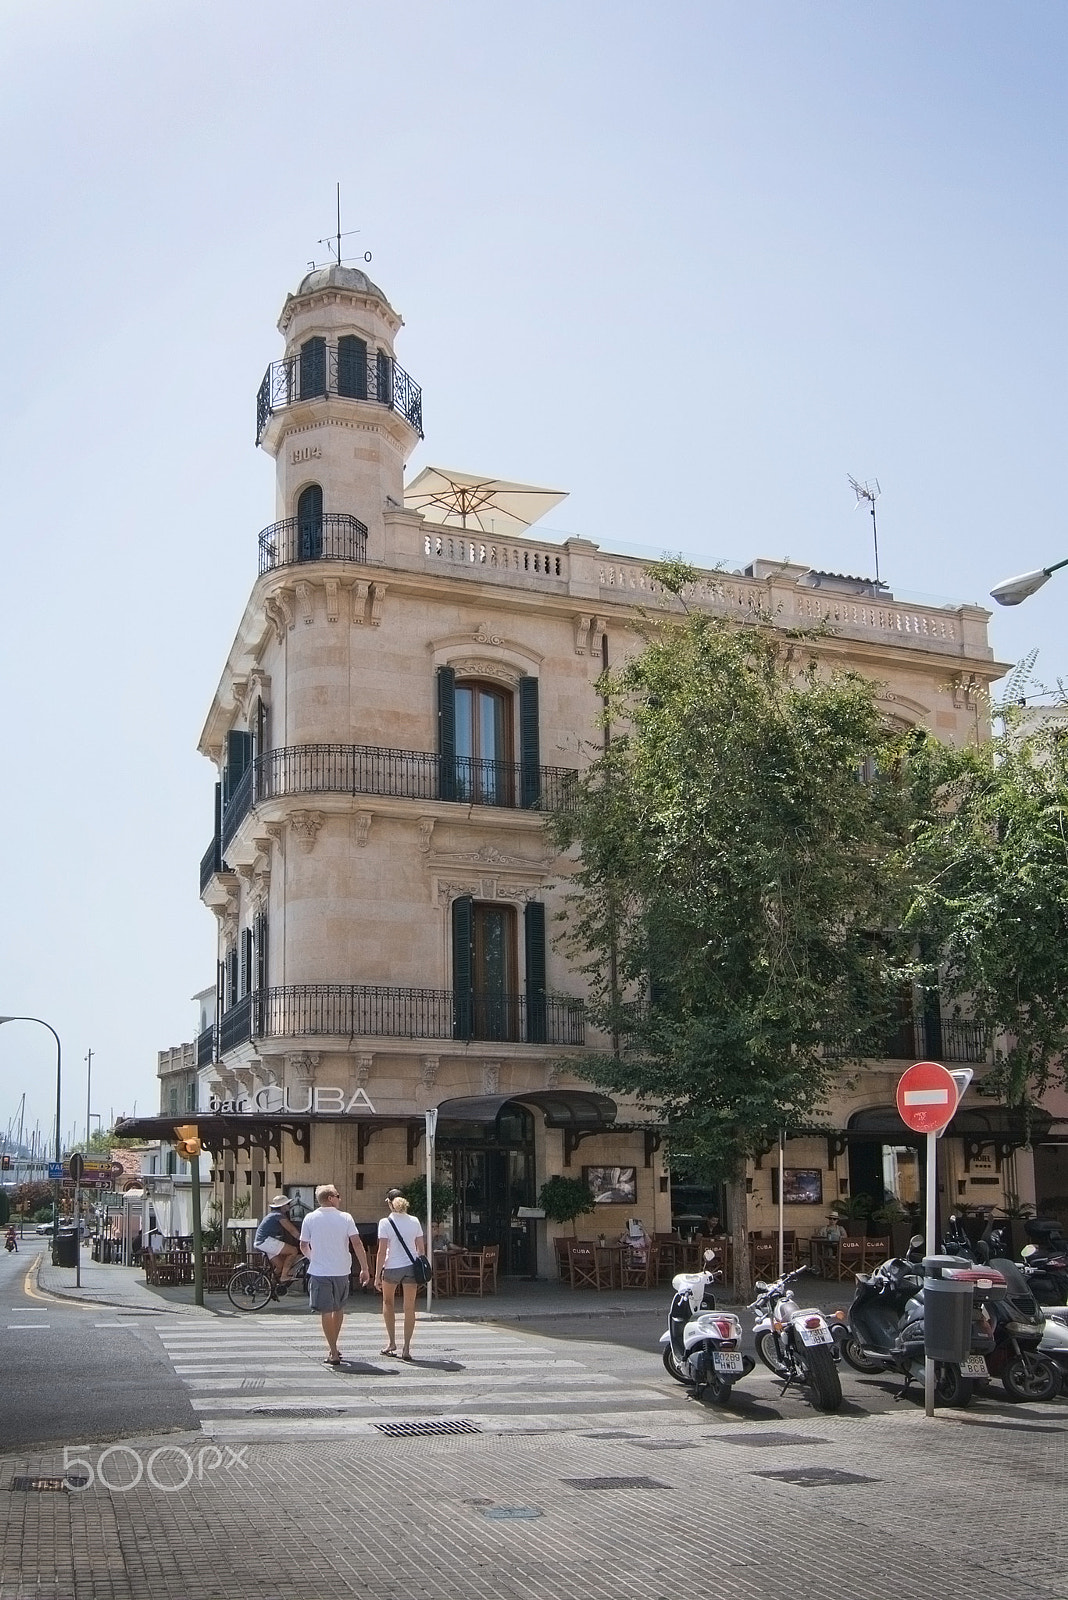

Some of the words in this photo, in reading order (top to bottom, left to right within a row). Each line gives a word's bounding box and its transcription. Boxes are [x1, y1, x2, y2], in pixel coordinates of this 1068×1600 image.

[209, 1095, 248, 1113] bar
[253, 1085, 377, 1114] CUBA
[968, 1364, 986, 1373] BCB
